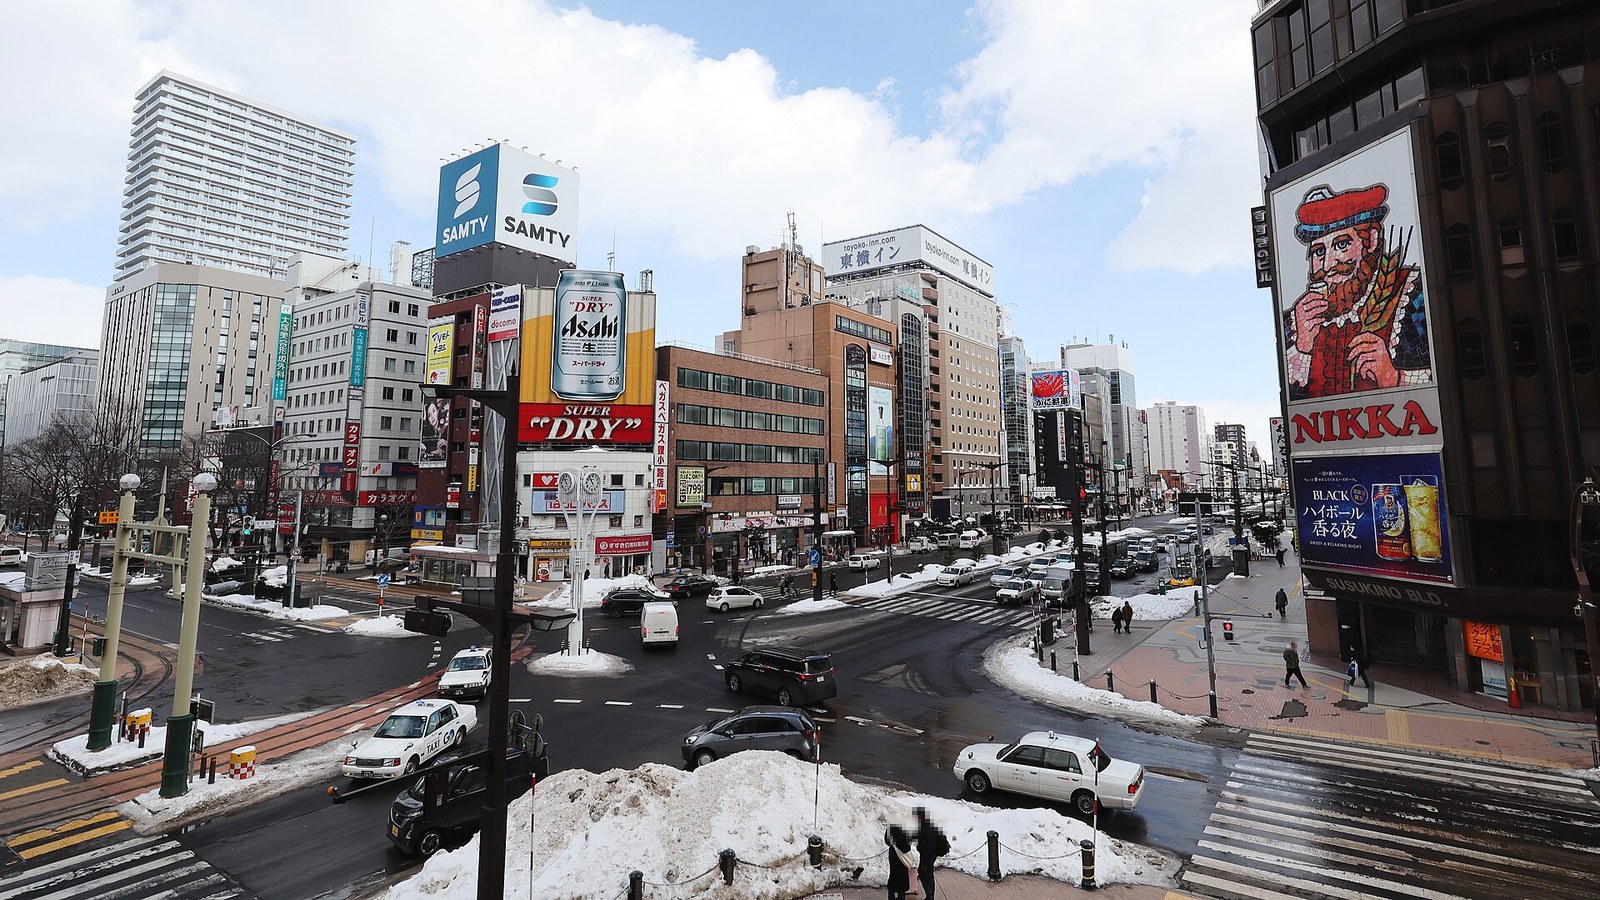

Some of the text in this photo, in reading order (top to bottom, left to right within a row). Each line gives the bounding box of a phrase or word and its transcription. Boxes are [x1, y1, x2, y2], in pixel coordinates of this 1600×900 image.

[442, 215, 489, 244] SAMTY
[504, 216, 571, 248] SAMTY
[843, 235, 896, 252] toyoko-inn.com
[925, 240, 960, 267] toyoko-inn.com
[839, 245, 902, 271] 東横イン
[962, 258, 991, 285] 東横イン
[569, 301, 613, 313] "DRY"
[490, 318, 517, 329] docomo
[561, 313, 619, 338] Asahi
[582, 342, 597, 353] 生
[563, 404, 611, 416] SUPER
[530, 416, 642, 440] “DRY”
[1291, 400, 1439, 444] NIKKA
[367, 494, 408, 504] カラオケ
[1313, 490, 1350, 501] BLACK
[1303, 504, 1365, 520] ハイボール
[1312, 519, 1357, 540] 香る夜
[1326, 577, 1449, 607] SUSUKINO BLD.
[426, 741, 440, 755] TAXI
